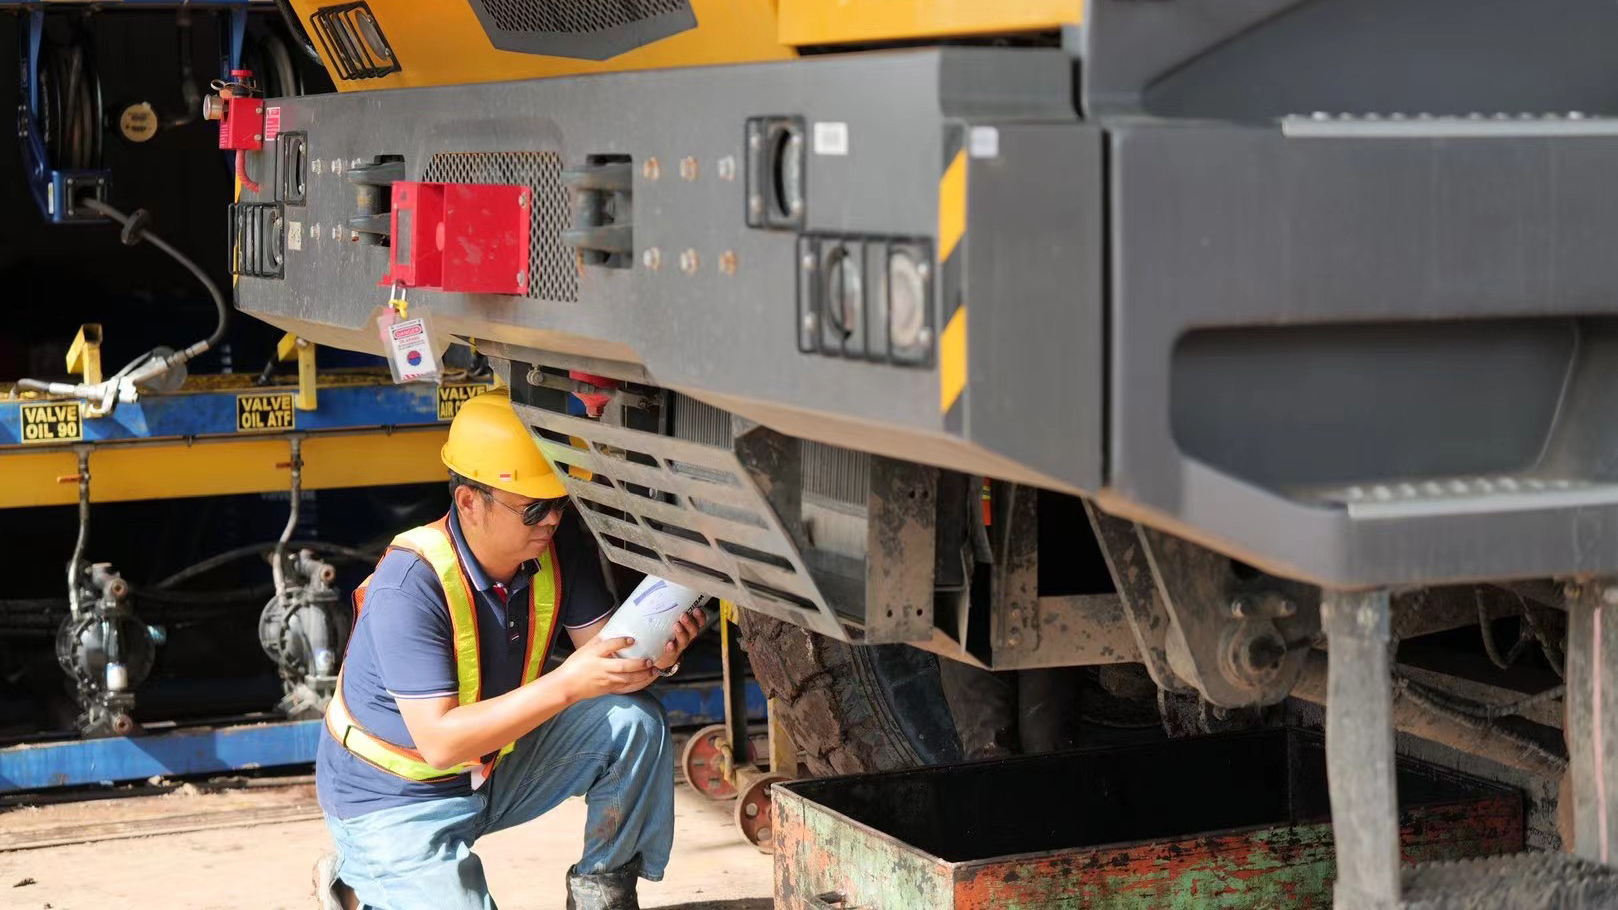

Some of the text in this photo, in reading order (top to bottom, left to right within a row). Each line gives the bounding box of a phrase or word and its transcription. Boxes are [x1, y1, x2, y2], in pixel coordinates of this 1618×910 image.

[440, 386, 486, 400] VALVE
[242, 395, 291, 411] VALVE
[440, 400, 455, 418] AIR
[25, 404, 78, 423] VALVE
[241, 410, 291, 428] OIL ATF
[26, 421, 78, 439] OIL 90
